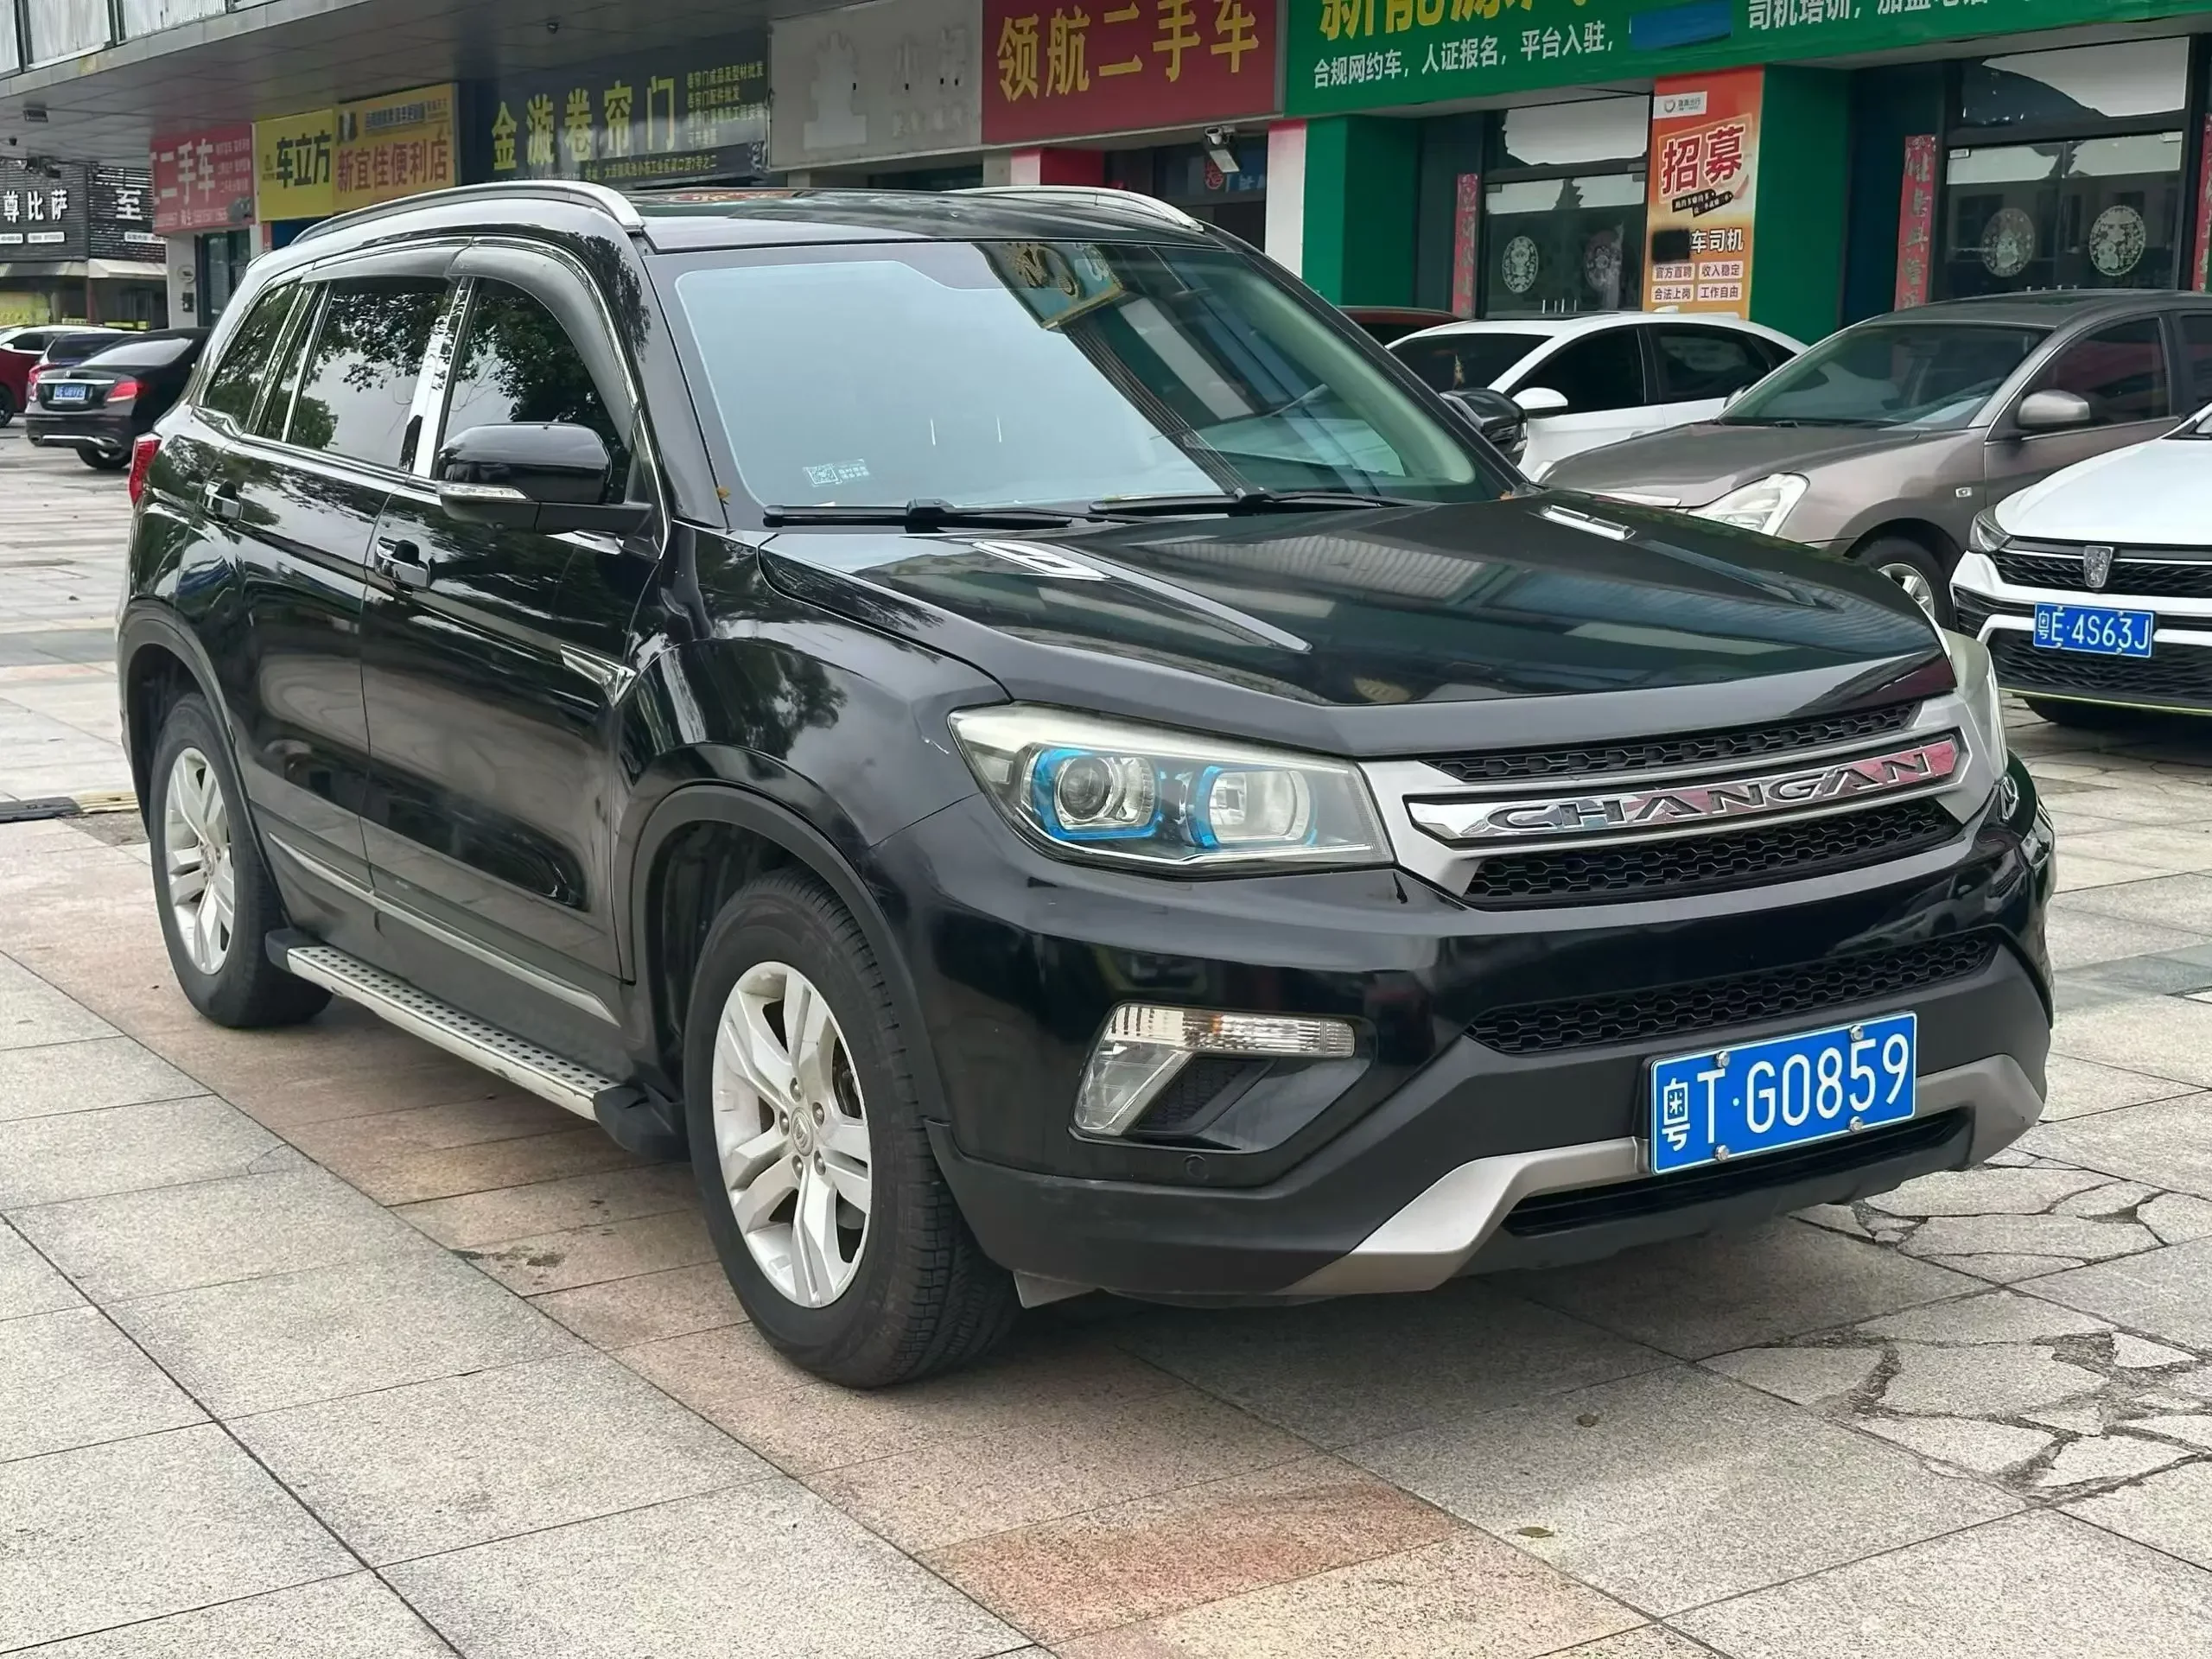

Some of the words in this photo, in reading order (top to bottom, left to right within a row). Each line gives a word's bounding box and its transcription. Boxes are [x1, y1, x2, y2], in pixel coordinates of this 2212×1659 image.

[996, 0, 1260, 102] 领航二手车
[159, 137, 216, 206] 二手车
[276, 130, 332, 189] 车立方
[337, 127, 448, 194] 新宜佳便利店
[1660, 124, 1745, 196] 招募
[3, 188, 67, 223] 尊比萨
[115, 188, 143, 221] 至
[1654, 287, 1691, 301] 合法上岗
[1700, 285, 1739, 299] 工作自由
[1656, 265, 1692, 279] 官方直聘
[1701, 264, 1740, 277] 收入稳定
[1486, 751, 1931, 829] CHANGAN
